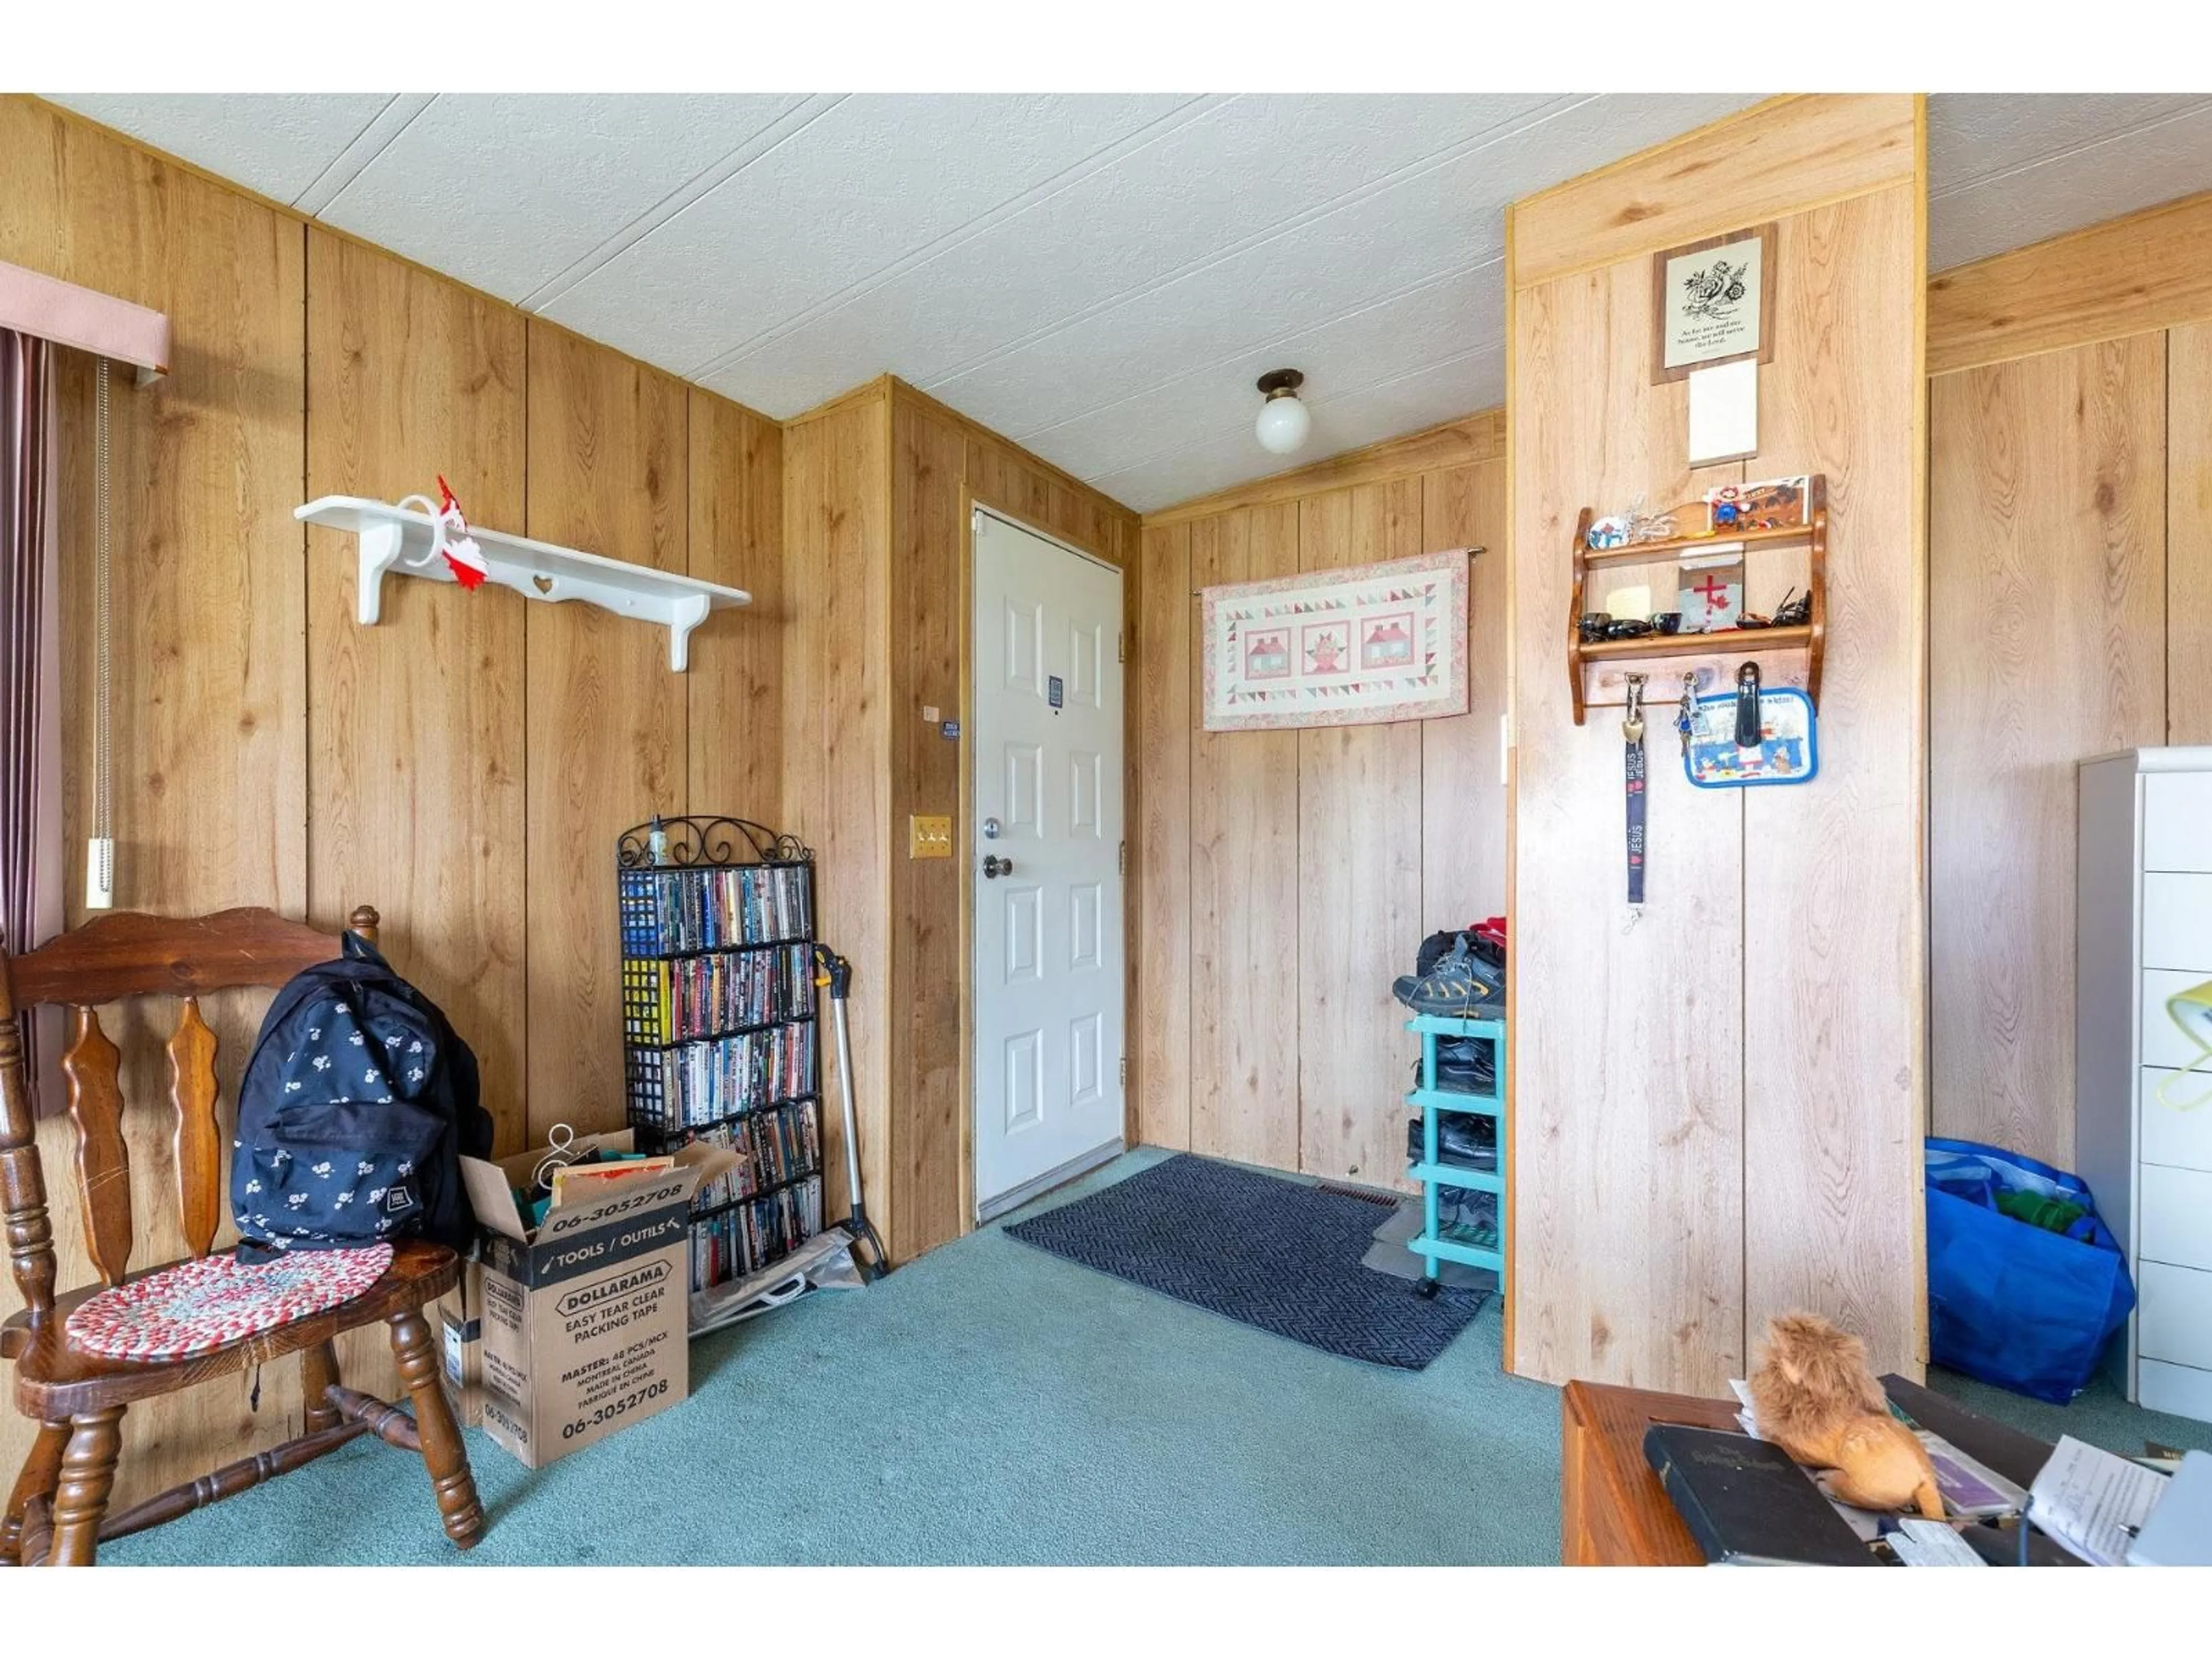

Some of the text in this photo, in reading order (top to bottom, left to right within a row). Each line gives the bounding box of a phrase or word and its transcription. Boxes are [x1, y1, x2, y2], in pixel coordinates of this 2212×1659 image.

[1631, 824, 1642, 854] JESUS
[552, 1183, 683, 1233] 06-3052708
[556, 1242, 605, 1267] TOOLS
[620, 1222, 665, 1247] OUTILS
[566, 1287, 665, 1332] EASY TEAR CLEAR
[567, 1266, 664, 1310] DOLLARAMA
[574, 1302, 658, 1343] PACKING TAPE
[562, 1331, 669, 1383] MASTER: 48 PCS/MCX
[577, 1349, 656, 1388] MONTREAL CANADA
[586, 1363, 647, 1395] MADE IN CHINA
[619, 1380, 630, 1391] EN
[631, 1369, 655, 1384] CHINE
[562, 1378, 669, 1439] 06-3052708
